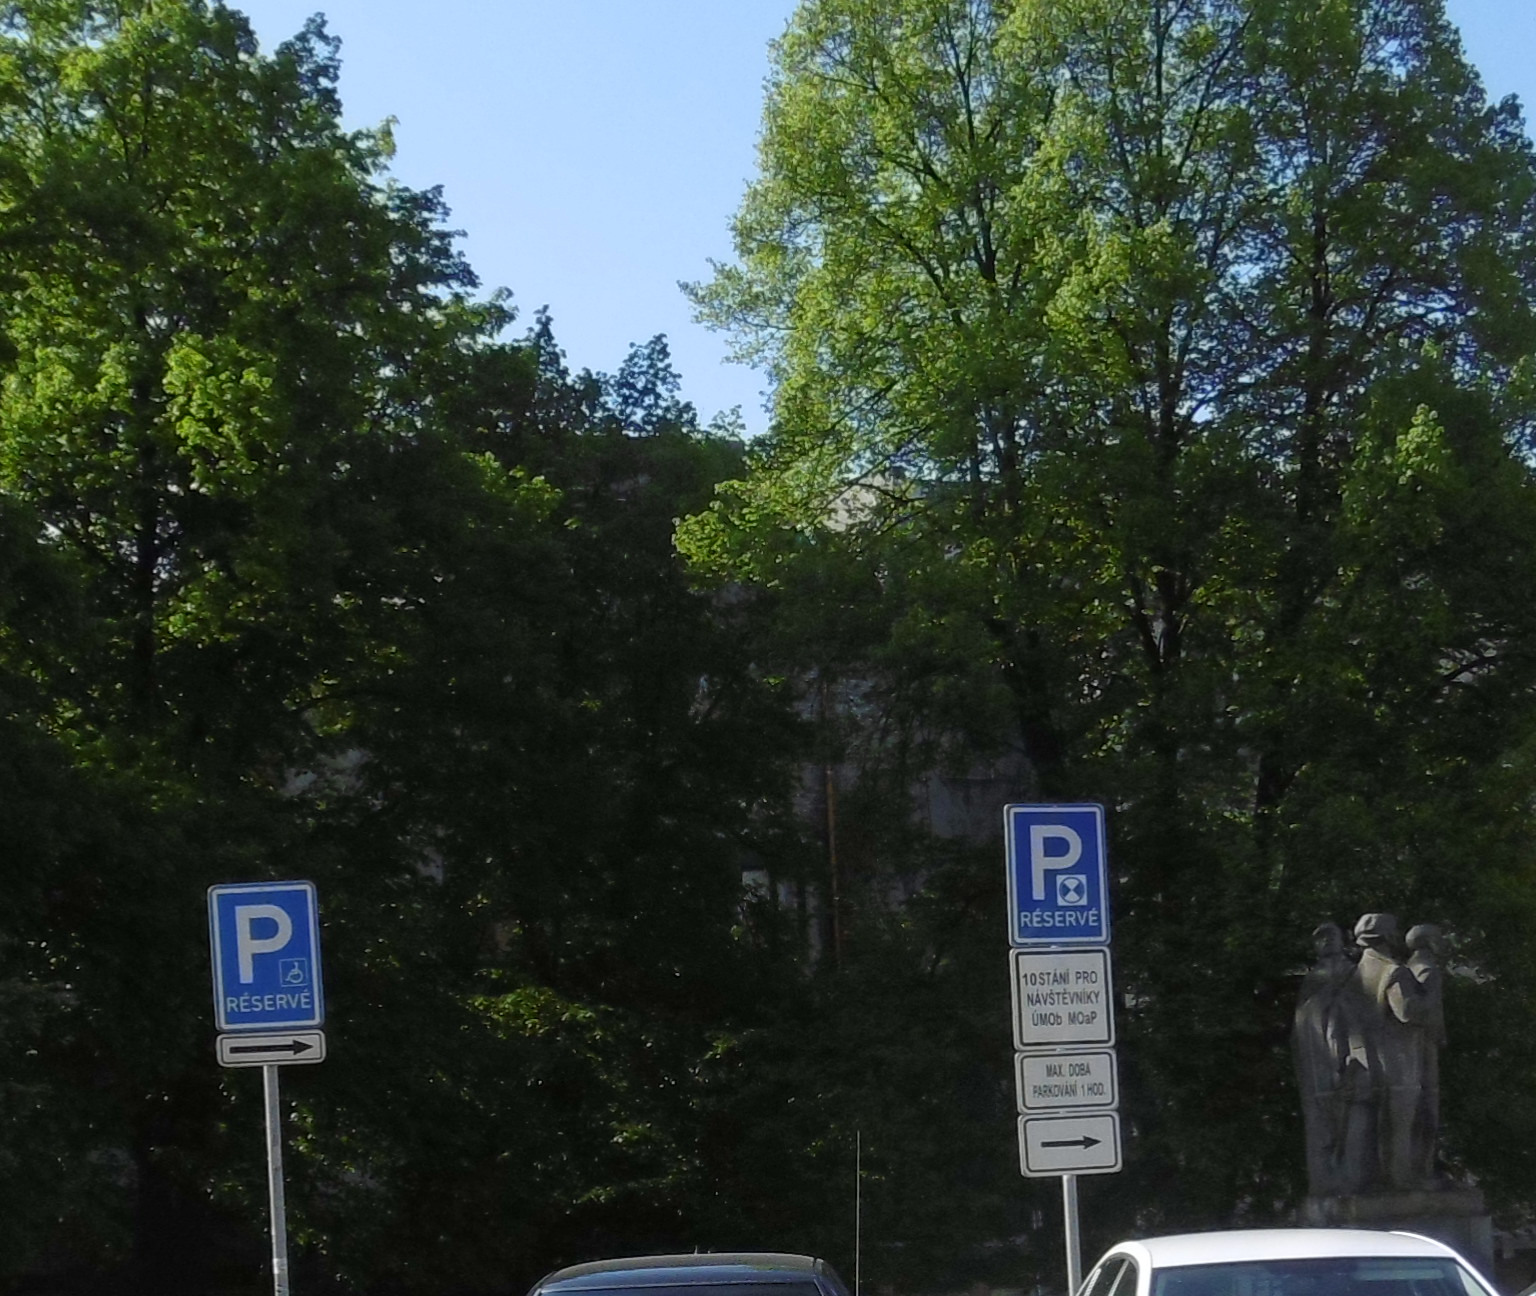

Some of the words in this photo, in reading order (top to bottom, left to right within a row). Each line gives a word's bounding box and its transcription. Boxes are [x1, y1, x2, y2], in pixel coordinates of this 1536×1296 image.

[1029, 824, 1083, 900] P
[1020, 907, 1099, 928] RÉSERVÉ
[235, 904, 293, 984] P
[1038, 969, 1070, 986] STÁNÍ
[1075, 970, 1098, 985] PRO
[226, 989, 311, 1012] RÉSERVÉ
[1068, 1010, 1097, 1025] MOaP
[1068, 1062, 1092, 1077] DOBA
